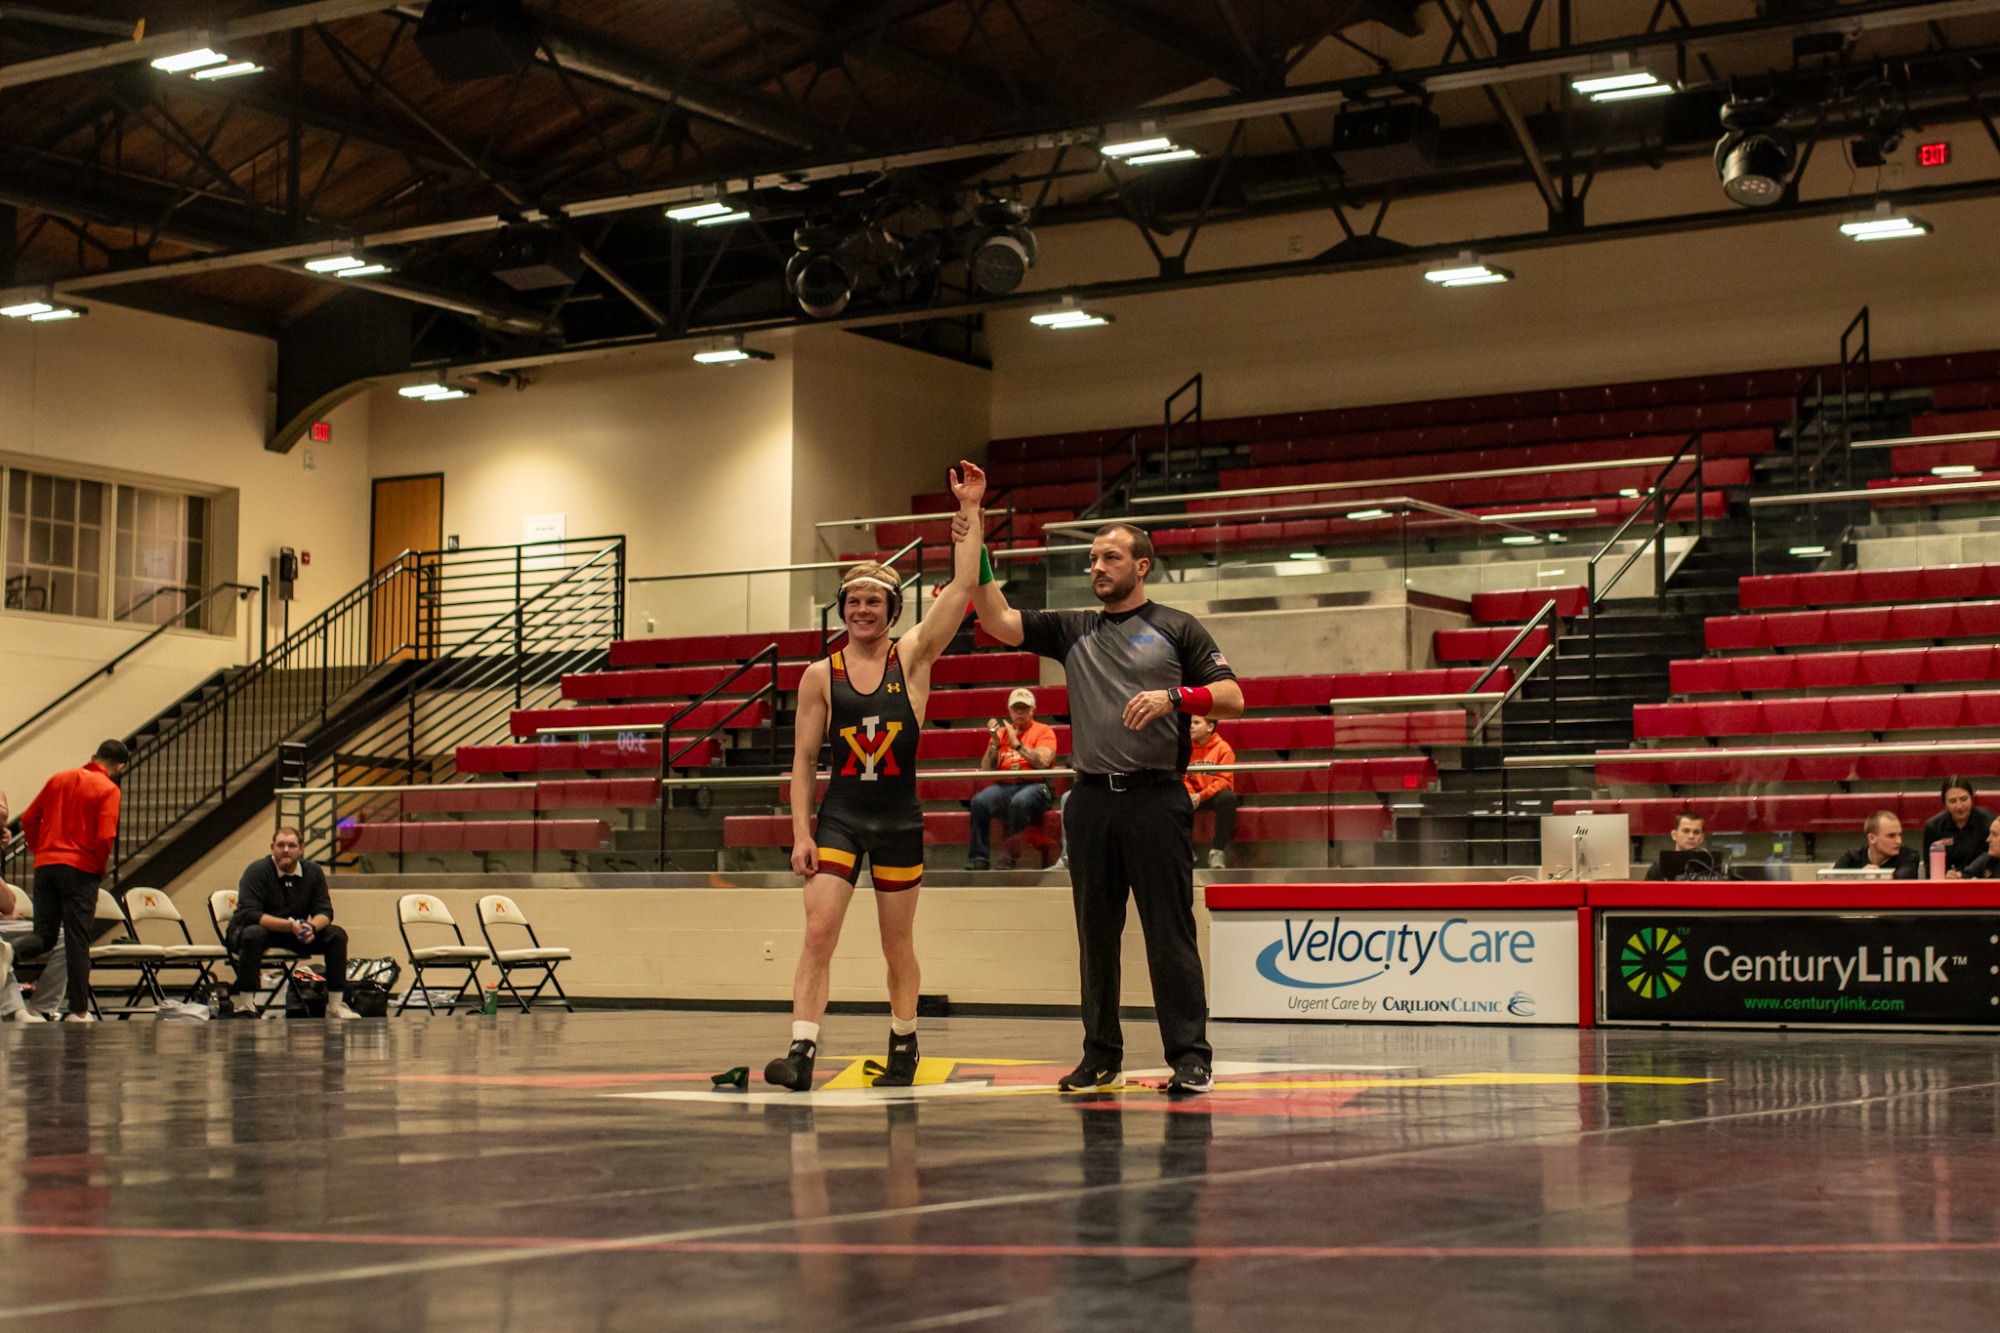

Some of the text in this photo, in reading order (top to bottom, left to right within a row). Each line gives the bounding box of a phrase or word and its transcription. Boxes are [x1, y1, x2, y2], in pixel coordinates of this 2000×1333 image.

[1921, 143, 1946, 166] EXIT
[1703, 945, 1950, 991] CenturyLink
[1288, 996, 1329, 1013] Urgent
[1331, 996, 1359, 1010] Care
[1361, 996, 1378, 1014] by
[1743, 996, 1905, 1014] www.centurylink.com
